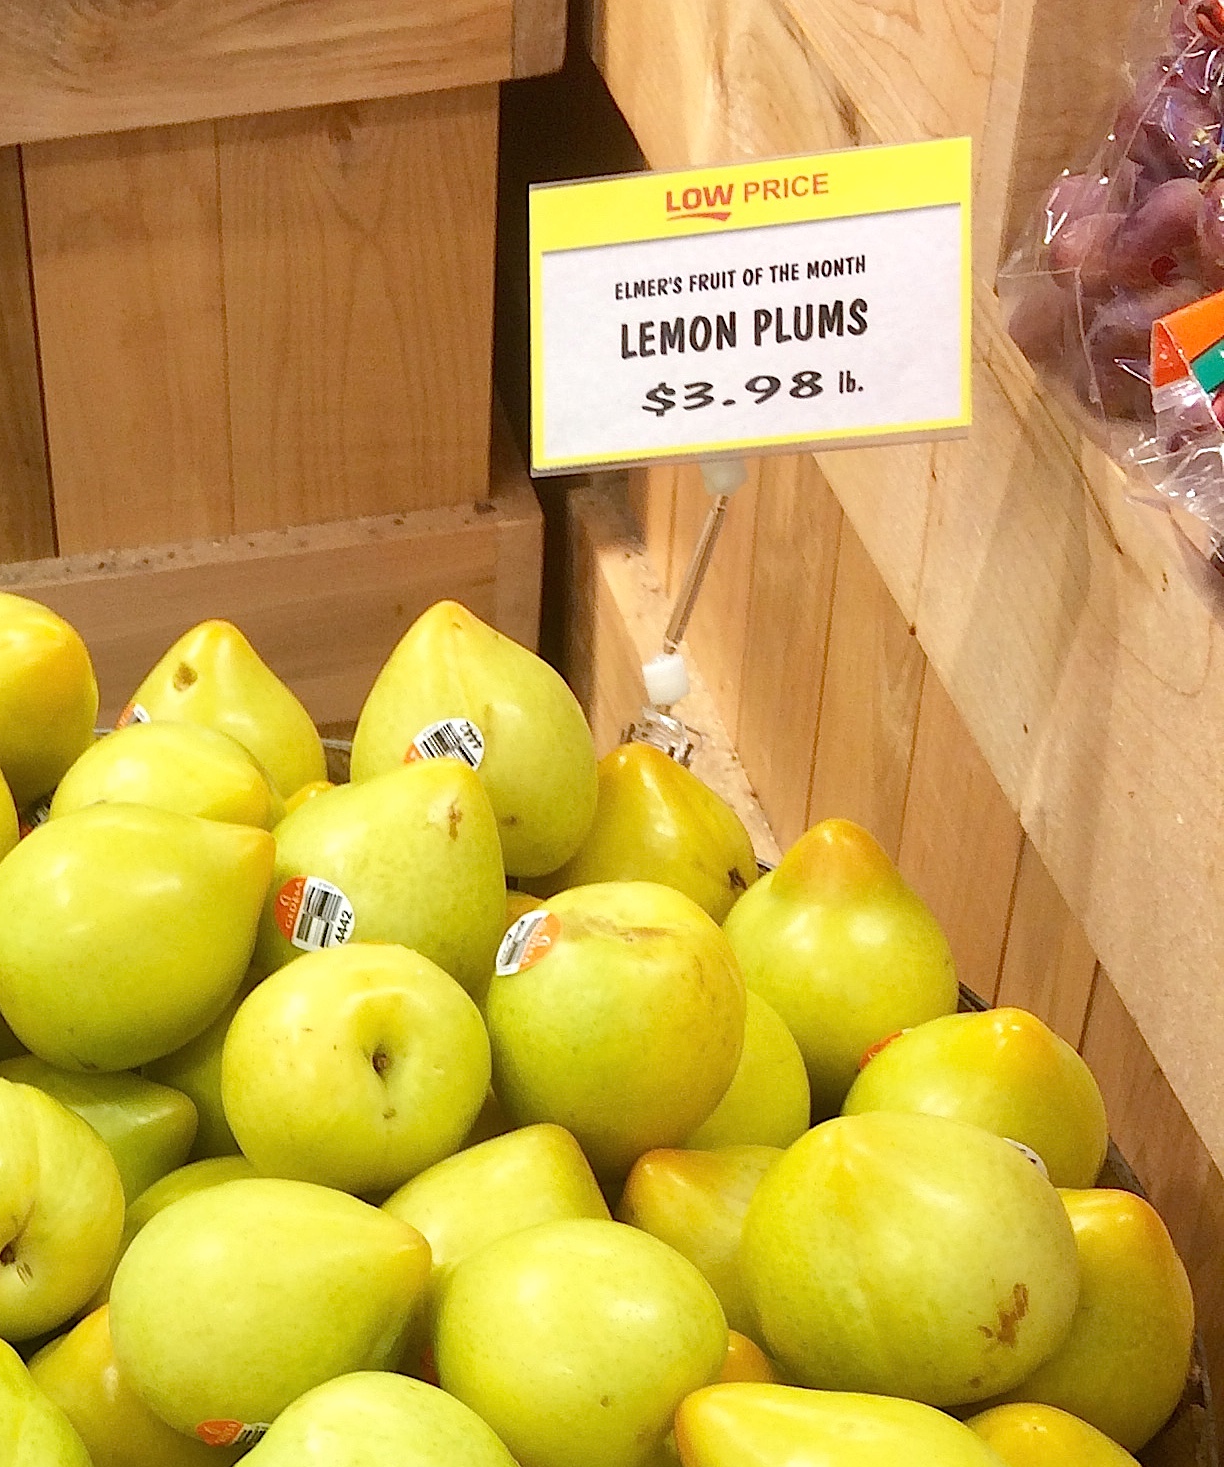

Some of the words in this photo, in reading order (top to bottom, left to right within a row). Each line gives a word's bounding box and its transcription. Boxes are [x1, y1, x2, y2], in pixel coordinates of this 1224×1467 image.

[665, 183, 734, 213] LOW
[743, 173, 830, 204] PRICE
[614, 276, 683, 301] ELMER'S
[688, 270, 737, 293] FRUIT
[742, 267, 764, 287] OF
[769, 264, 801, 283] THE
[806, 254, 867, 279] MONTH
[620, 311, 738, 360] LEMON
[753, 298, 869, 346] PLUMS
[641, 370, 825, 418] $3.98
[838, 370, 865, 395] lb.
[459, 721, 483, 749] 4442
[334, 909, 354, 945] 4442
